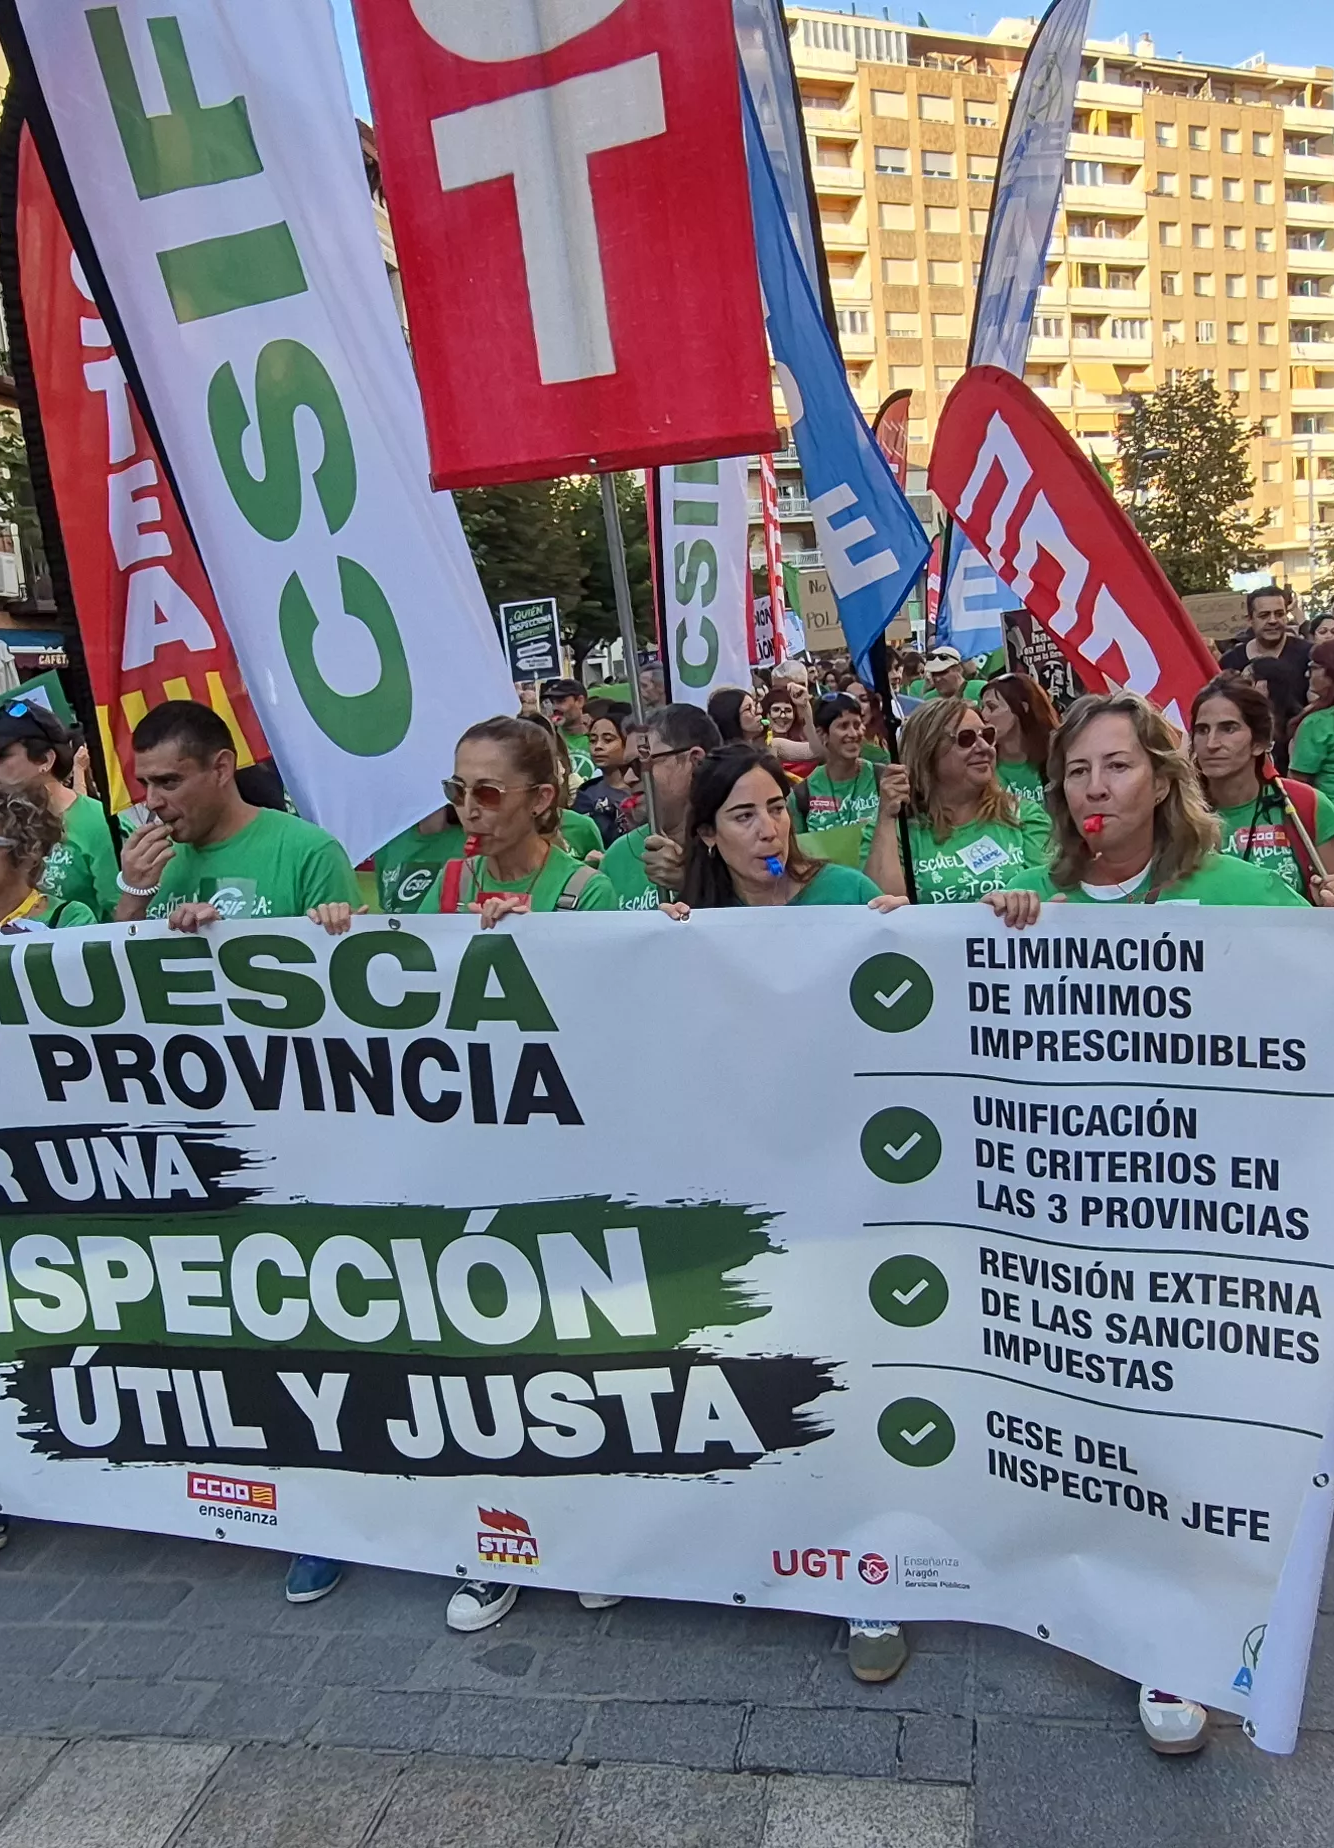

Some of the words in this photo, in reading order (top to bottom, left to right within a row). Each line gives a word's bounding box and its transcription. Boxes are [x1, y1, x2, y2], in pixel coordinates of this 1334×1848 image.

[85, 5, 413, 757] CSIF
[966, 932, 1205, 973] ELIMINACIÓN
[968, 981, 1014, 1015] DE
[1024, 976, 1192, 1019] MÍNIMOS
[970, 1026, 1307, 1072] IMPRESCINDIBLES
[29, 1033, 585, 1126] PROVINCIA
[973, 1096, 1198, 1140] UNIFICACIÓN
[36, 1135, 210, 1203] UNA
[975, 1138, 1016, 1174] DE
[1026, 1146, 1217, 1187] CRITERIOS
[1232, 1156, 1280, 1192] EN
[977, 1180, 1036, 1219] LAS
[1047, 1193, 1068, 1224] 3
[1081, 1194, 1310, 1241] PROVINCIAS
[979, 1247, 1135, 1301] REVISIÓN
[1149, 1271, 1322, 1319] EXTERNA
[981, 1288, 1022, 1324] DE
[1032, 1301, 1093, 1340] LAS
[1105, 1313, 1320, 1364] SANCIONES
[982, 1327, 1174, 1392] IMPUESTAS
[50, 1346, 267, 1450] ÚTIL
[277, 1371, 350, 1452] Y
[386, 1365, 766, 1461] JUSTA
[986, 1410, 1063, 1458] CESE
[1074, 1434, 1138, 1476] DEL
[192, 1477, 250, 1501] CCOO
[198, 1504, 278, 1526] enseñanza
[988, 1449, 1169, 1521] INSPECTOR
[1181, 1500, 1270, 1543] JEFE
[479, 1536, 537, 1557] STEA
[772, 1547, 851, 1581] UGT
[903, 1555, 960, 1568] Enseñanza
[904, 1568, 940, 1580] Aragón
